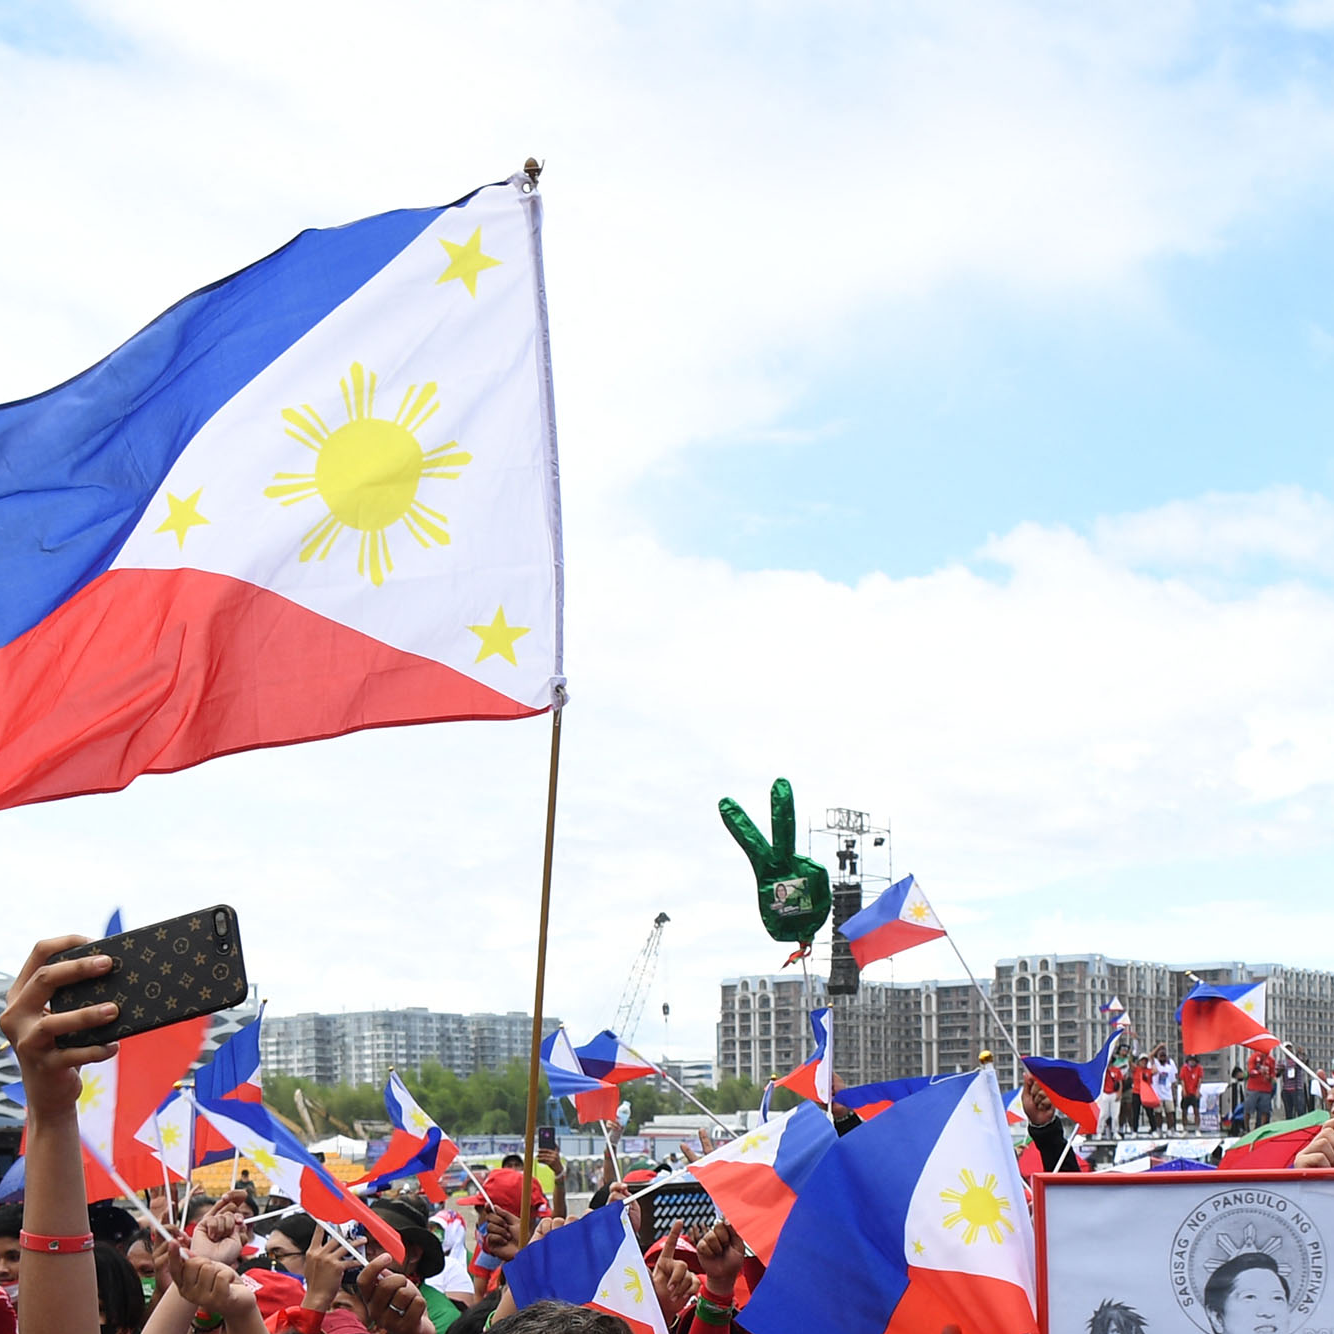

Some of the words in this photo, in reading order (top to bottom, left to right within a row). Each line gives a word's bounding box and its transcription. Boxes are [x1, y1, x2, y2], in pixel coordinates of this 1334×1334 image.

[1212, 1192, 1287, 1212] PANGULO
[1186, 1211, 1207, 1231] NG
[1291, 1213, 1312, 1234] NG
[1173, 1238, 1194, 1308] SAGISAG
[1297, 1241, 1323, 1315] PILIPINAS
